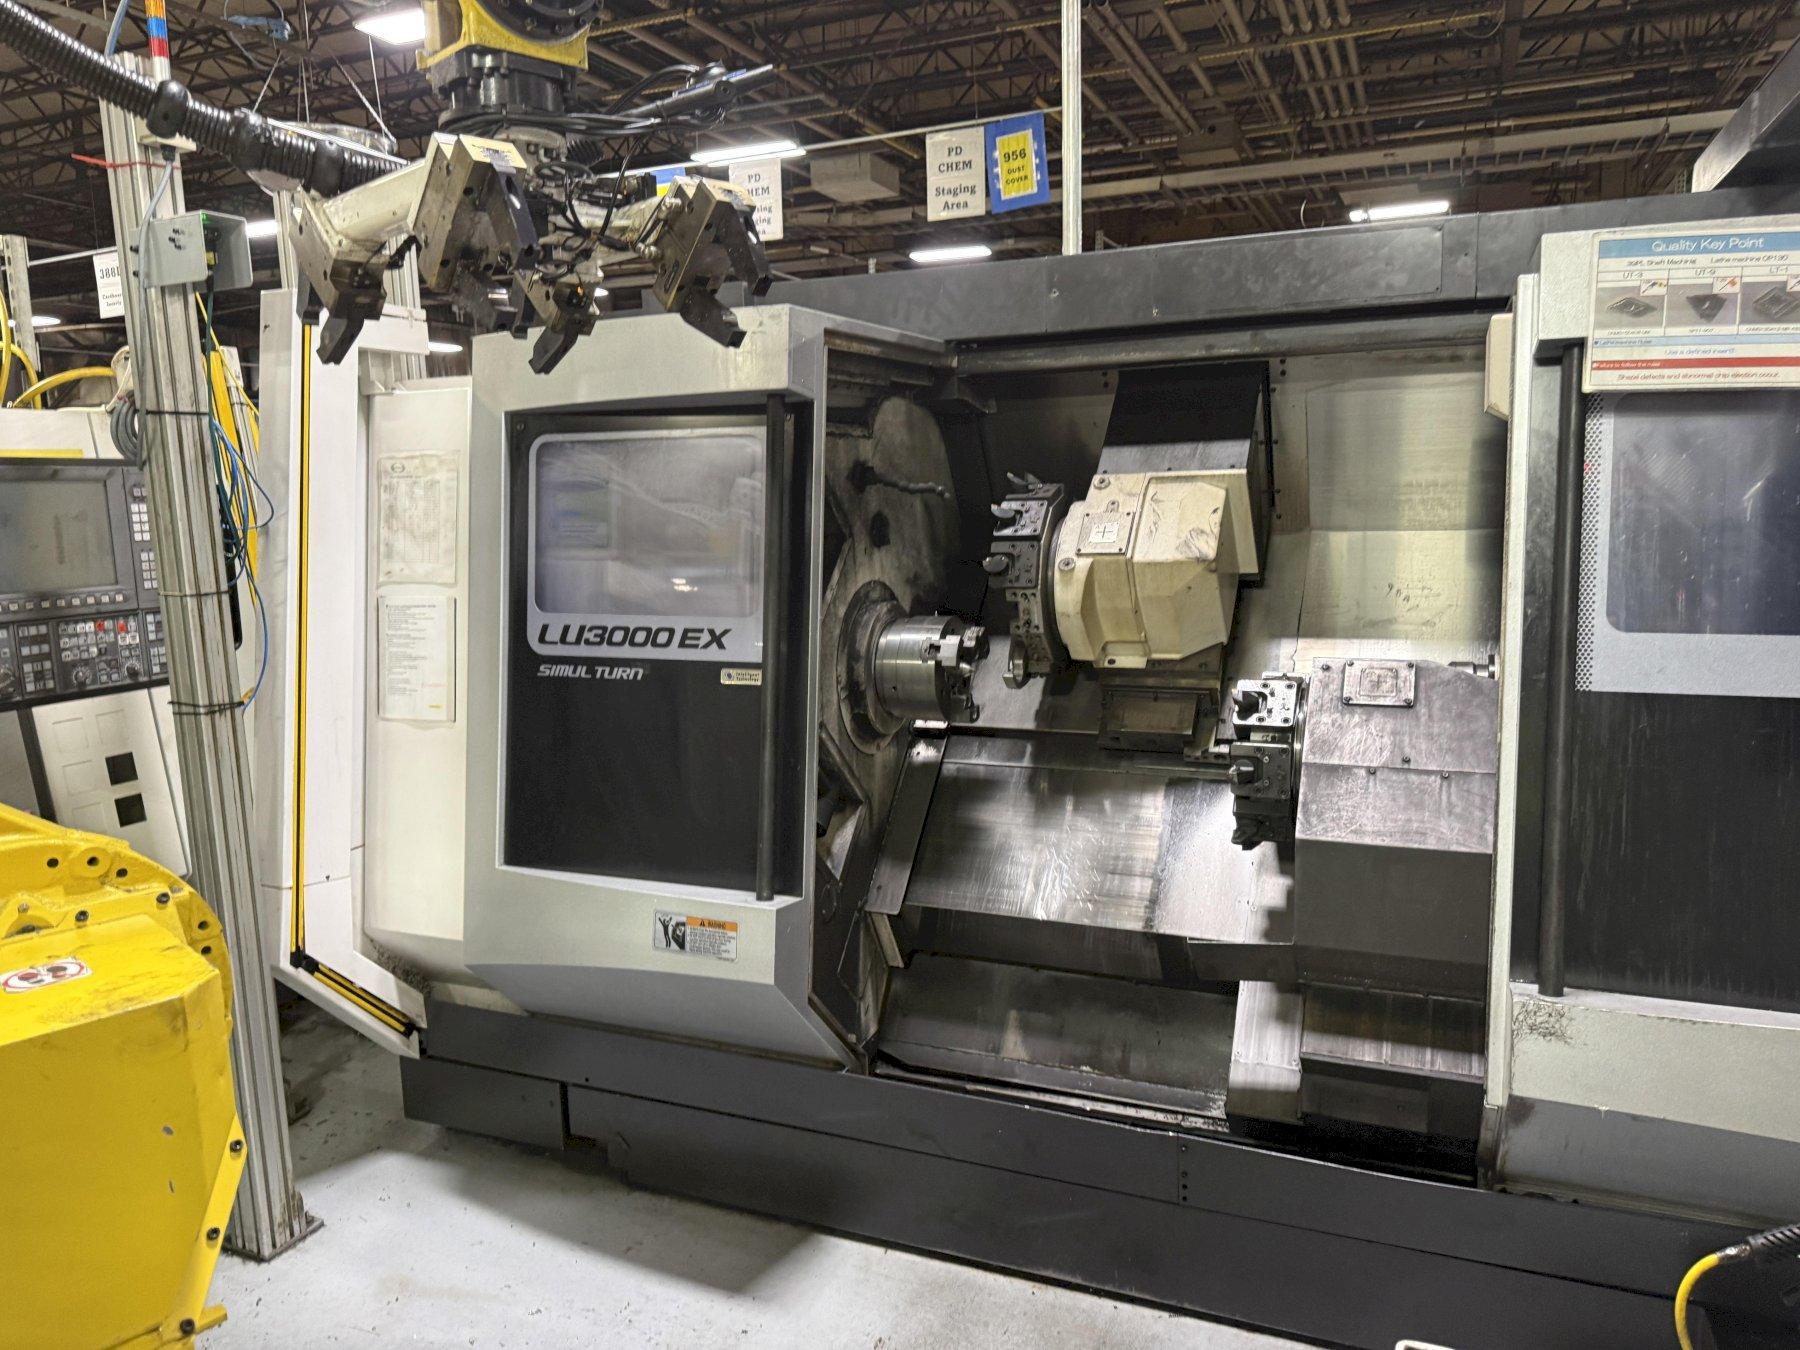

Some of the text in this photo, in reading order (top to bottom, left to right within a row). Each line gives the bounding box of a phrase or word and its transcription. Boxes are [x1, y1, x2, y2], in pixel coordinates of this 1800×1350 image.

[947, 145, 963, 157] PD
[1003, 148, 1027, 163] 956
[938, 160, 973, 173] CHEM
[1007, 165, 1025, 175] DUST
[748, 173, 761, 183] PD
[1005, 175, 1029, 185] COVER
[747, 186, 770, 197] HEM
[935, 183, 977, 198] Staging
[942, 200, 969, 211] Area
[1651, 236, 1766, 252] Quality Key Point
[537, 623, 733, 650] LU3000 EX
[537, 664, 644, 681] SIMUL TURN
